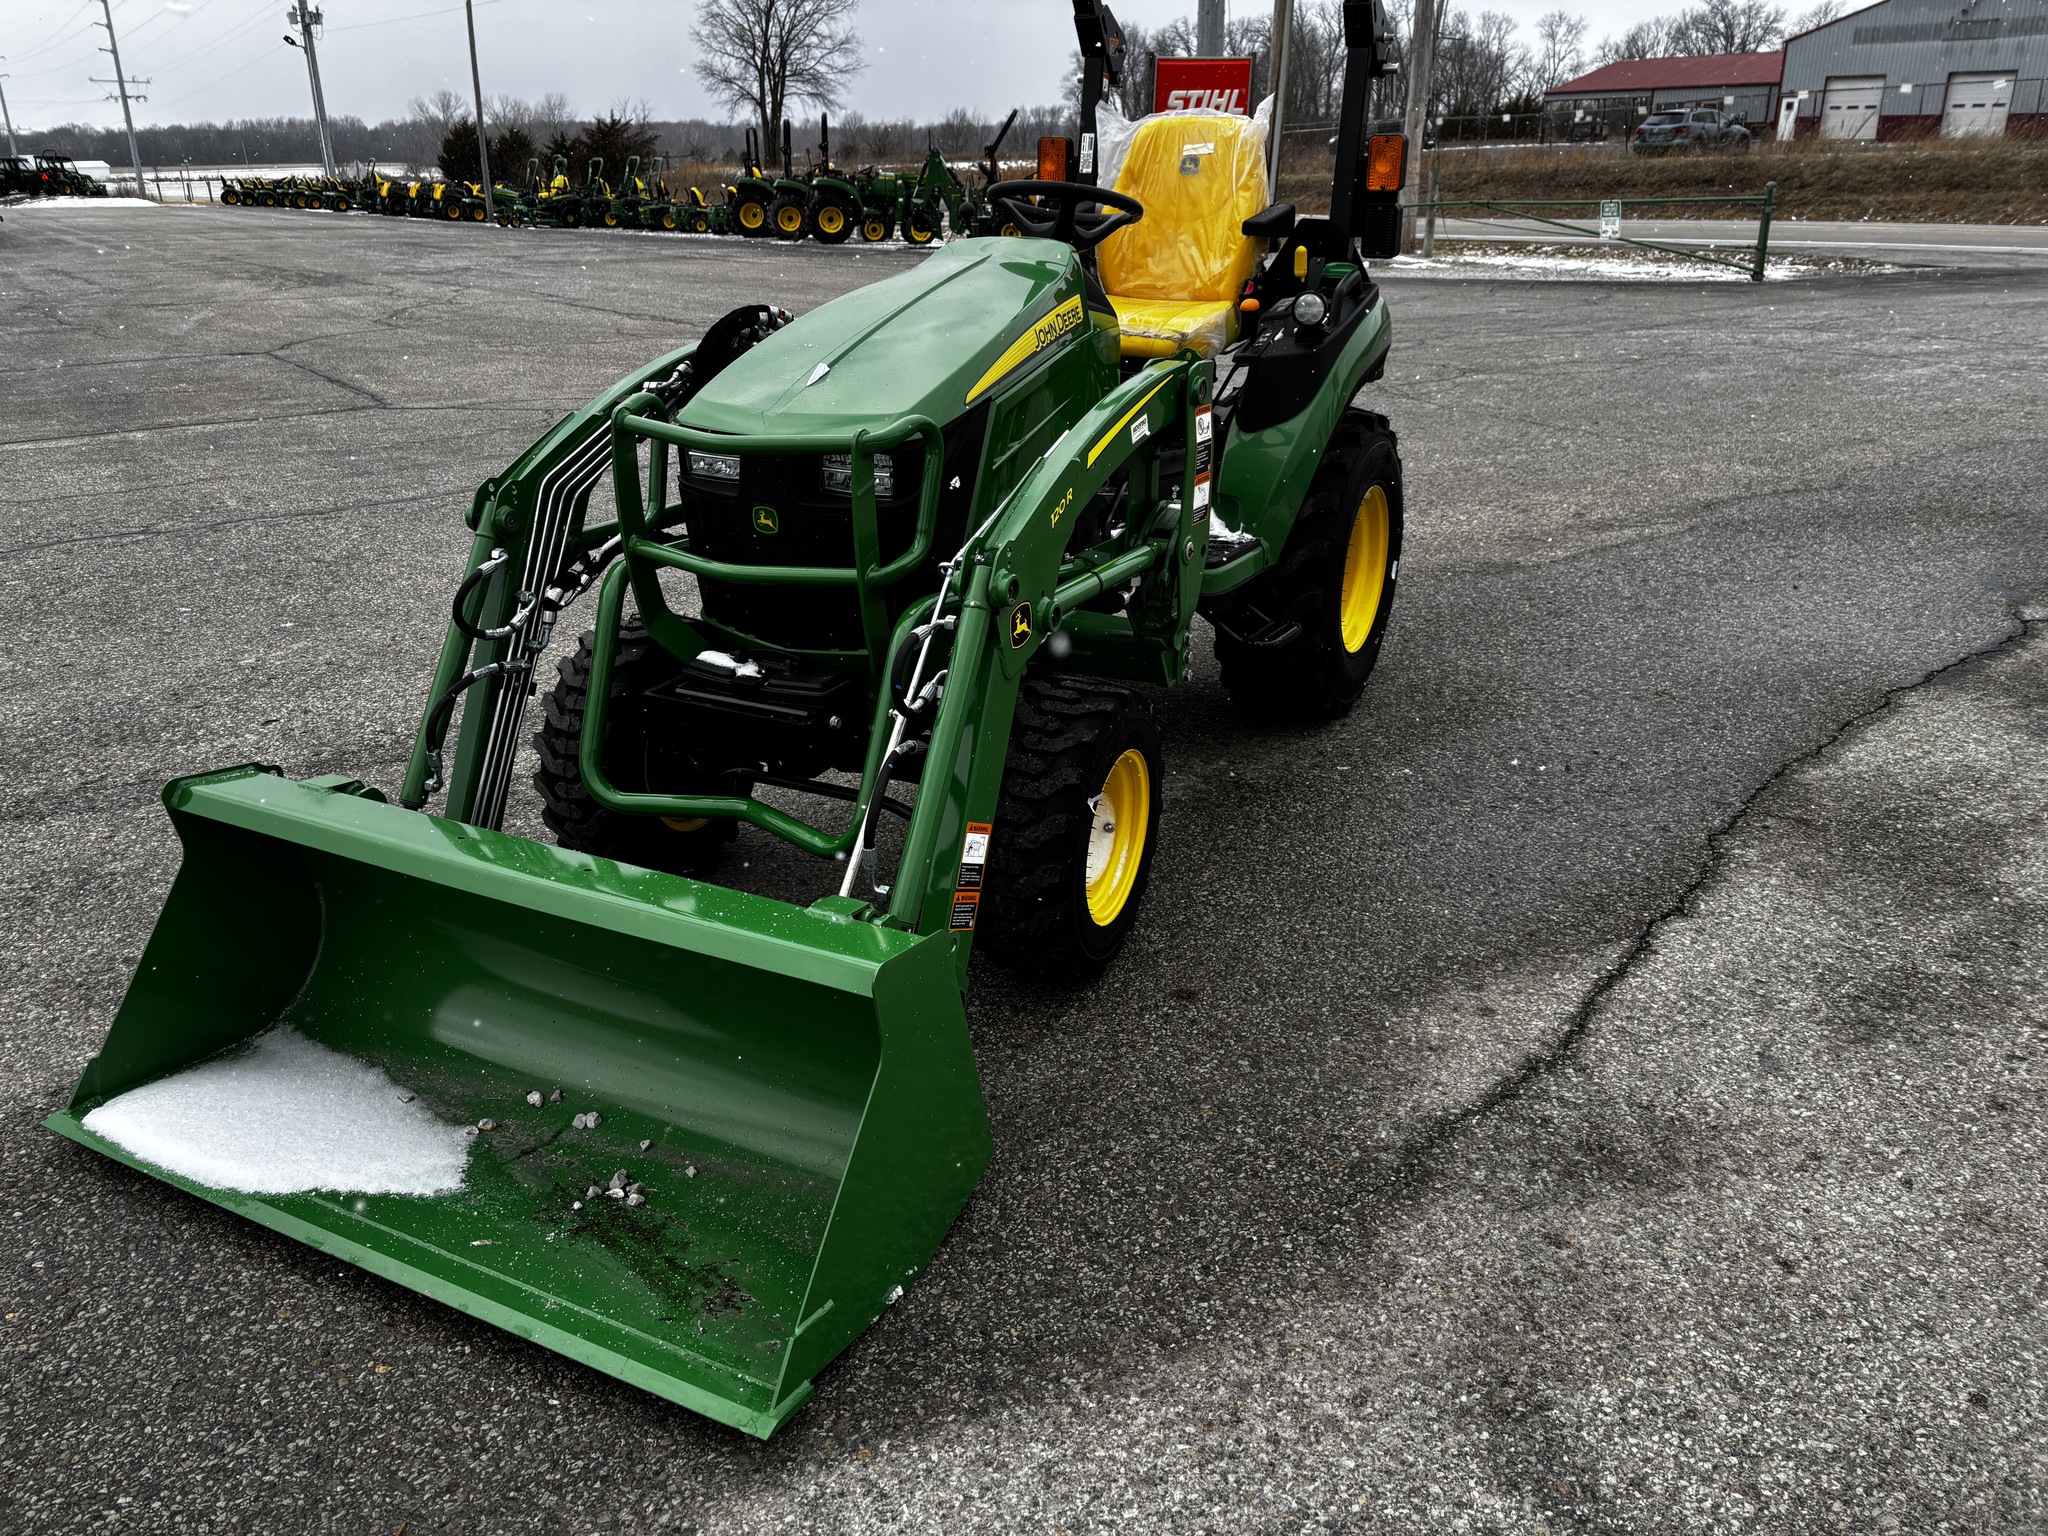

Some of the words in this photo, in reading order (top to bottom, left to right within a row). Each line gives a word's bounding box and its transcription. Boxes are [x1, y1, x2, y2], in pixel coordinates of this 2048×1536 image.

[1166, 89, 1245, 115] STIHL
[1034, 320, 1059, 349] JOHN
[1055, 305, 1082, 331] DEERE
